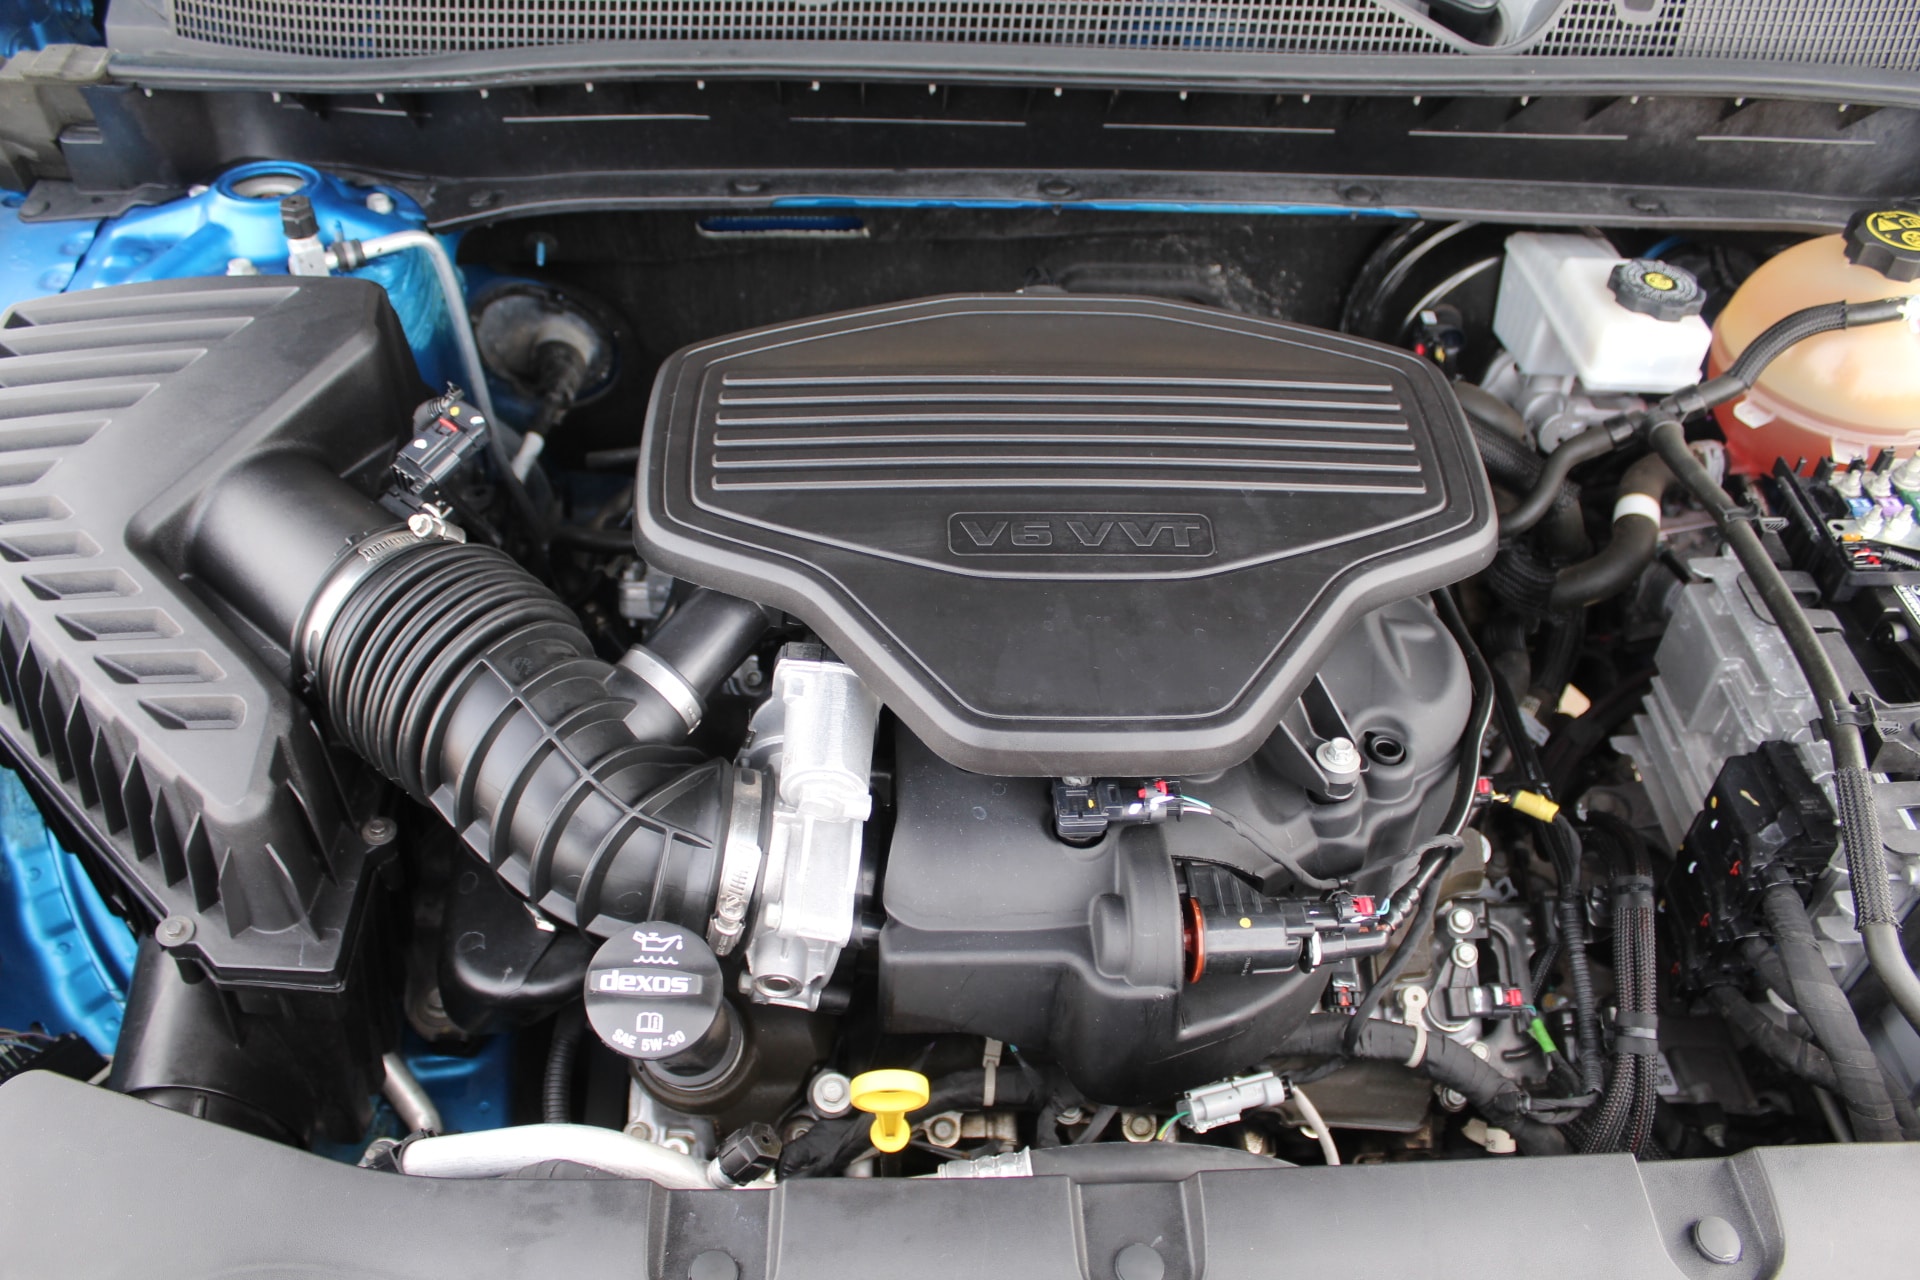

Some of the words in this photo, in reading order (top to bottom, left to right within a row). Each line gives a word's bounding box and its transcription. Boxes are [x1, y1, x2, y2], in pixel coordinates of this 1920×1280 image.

[959, 521, 1053, 546] V6
[1066, 521, 1200, 547] VVT
[599, 969, 689, 993] dexos
[612, 1028, 637, 1049] SAE
[641, 1030, 686, 1052] 5W-30
